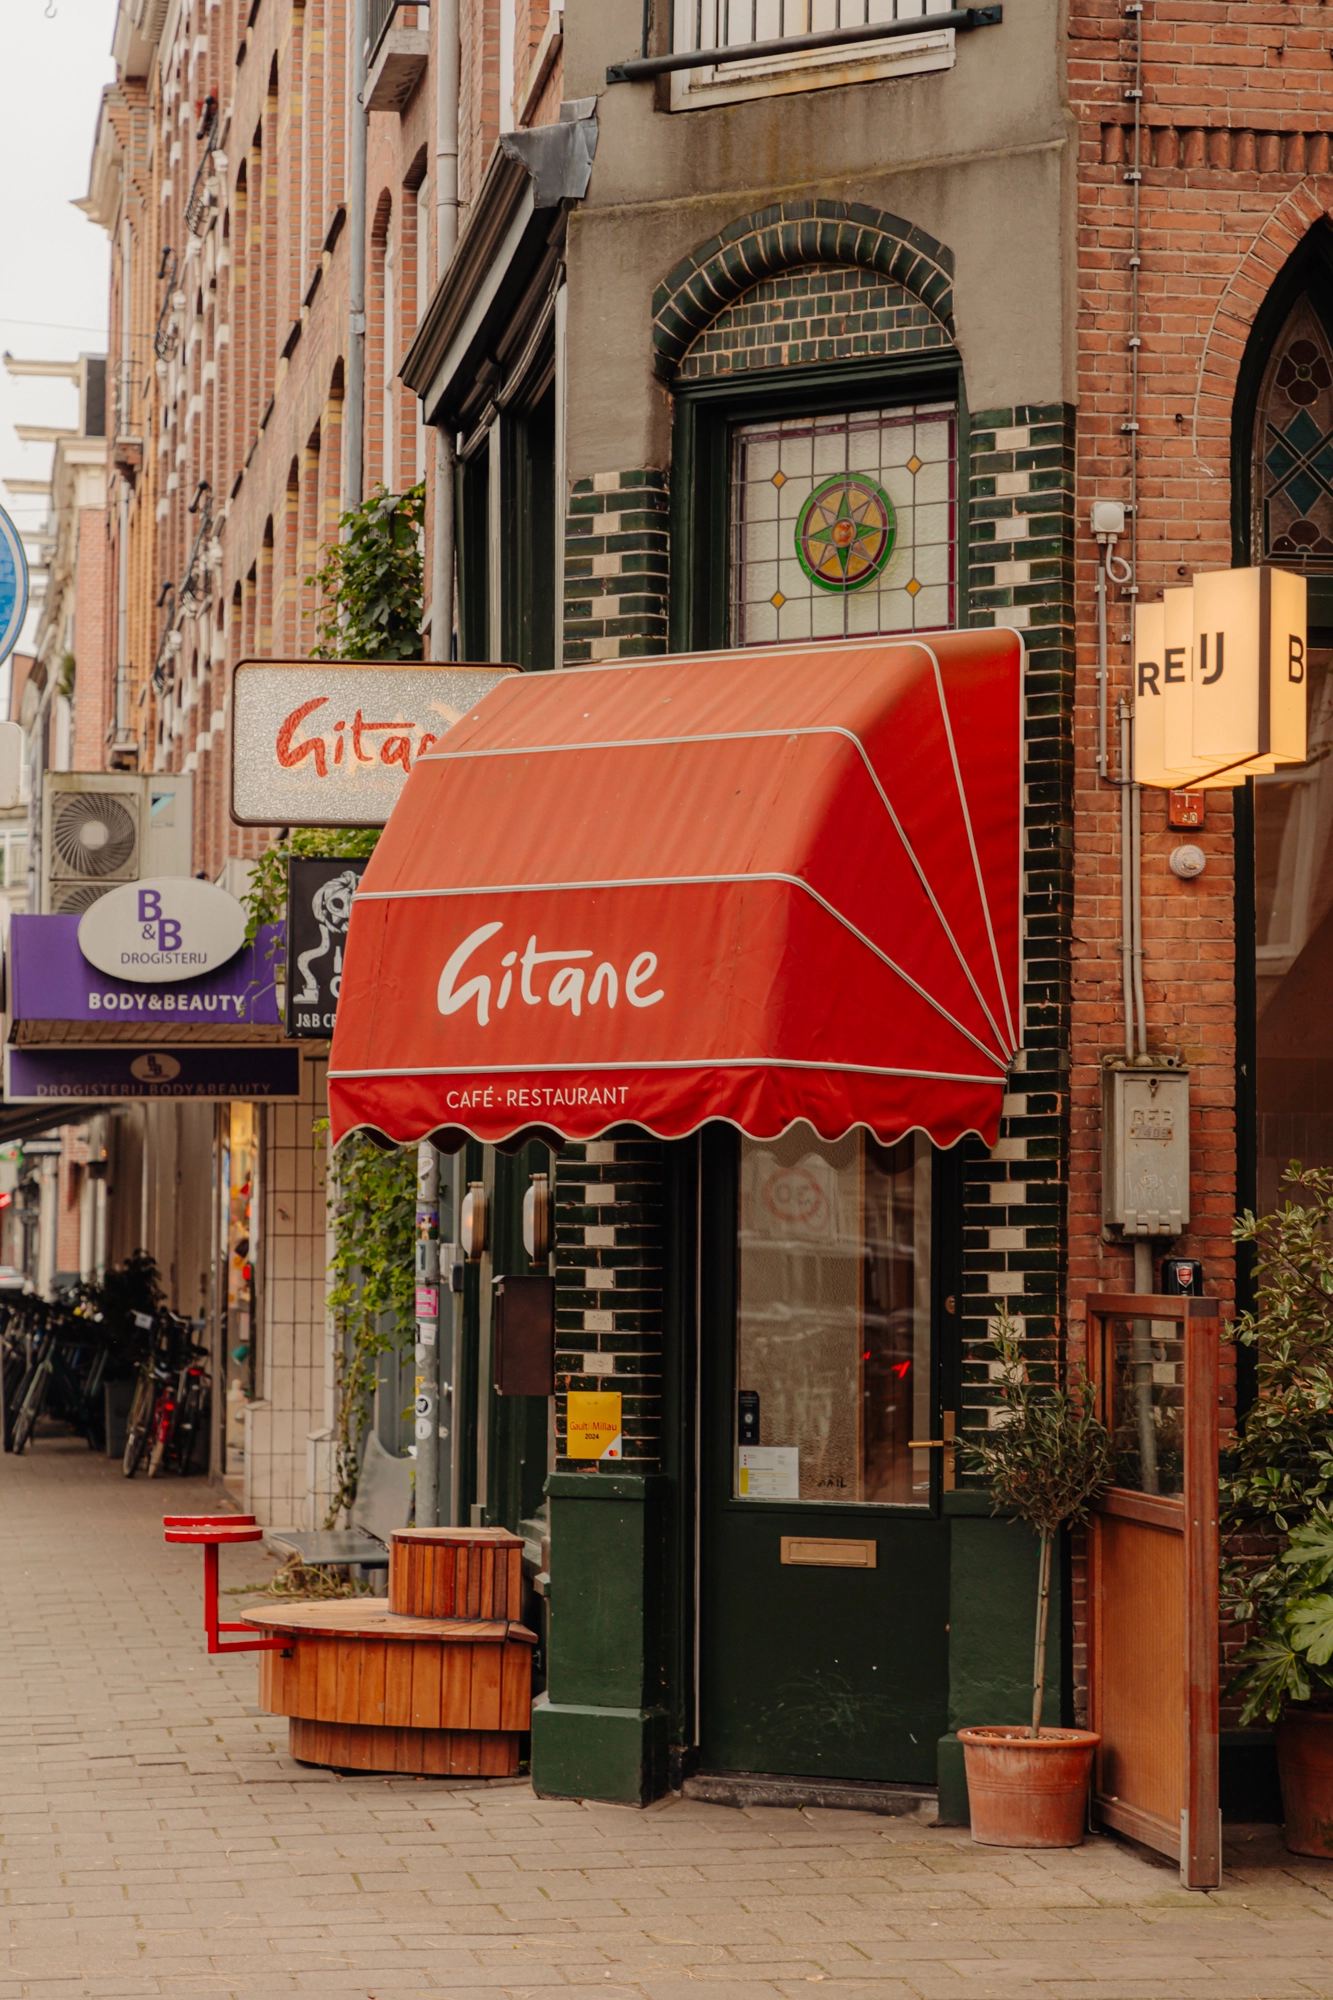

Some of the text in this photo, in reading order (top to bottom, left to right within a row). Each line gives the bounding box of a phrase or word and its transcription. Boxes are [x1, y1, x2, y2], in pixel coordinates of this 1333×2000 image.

[1288, 633, 1304, 684] B
[120, 952, 208, 965] DROGISTERIJ
[437, 921, 665, 1027] Gitane
[88, 992, 245, 1013] BODY&BEAUTY
[296, 1012, 321, 1029] J&B
[36, 1083, 272, 1097] DROGISTERIJ BODY&BEAUTY
[446, 1086, 629, 1109] CAFÉ RESTAURANT
